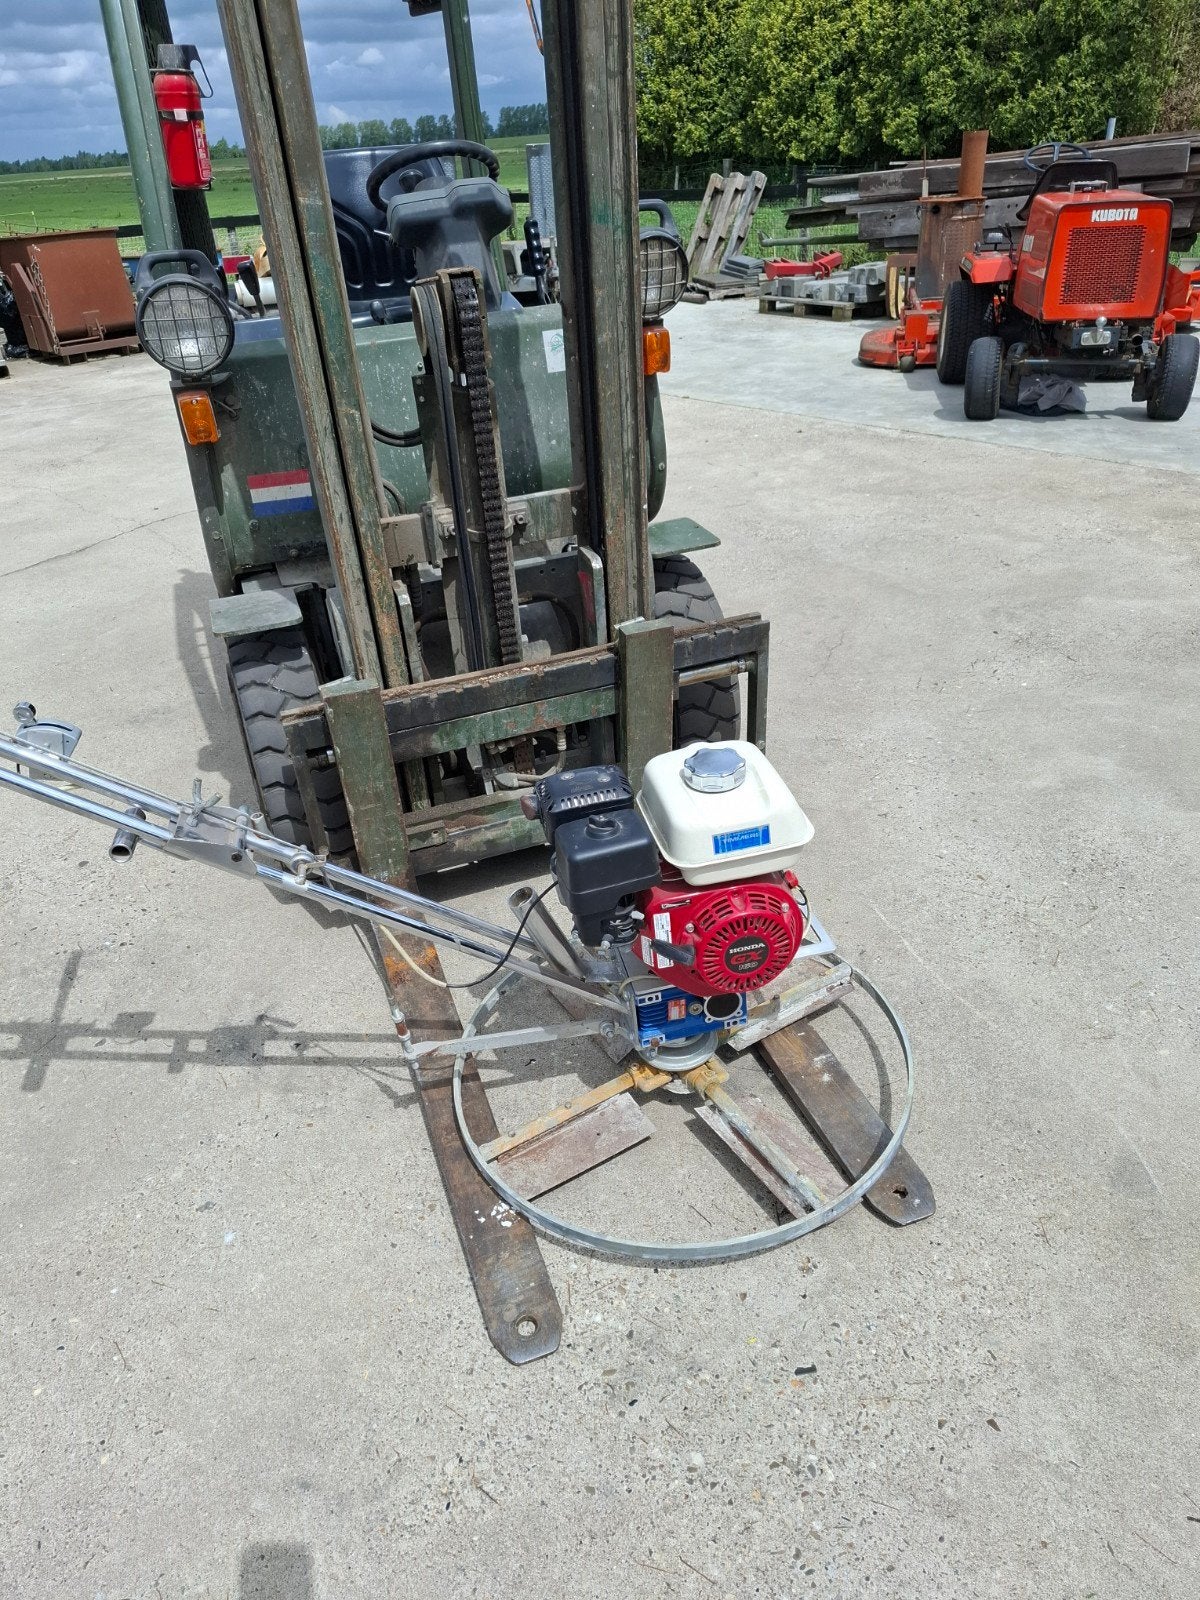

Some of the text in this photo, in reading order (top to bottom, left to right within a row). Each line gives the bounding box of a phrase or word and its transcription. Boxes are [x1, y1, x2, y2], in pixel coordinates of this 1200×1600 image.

[1091, 208, 1139, 222] KUBOTA
[729, 942, 766, 954] HONDA
[730, 949, 763, 965] GX
